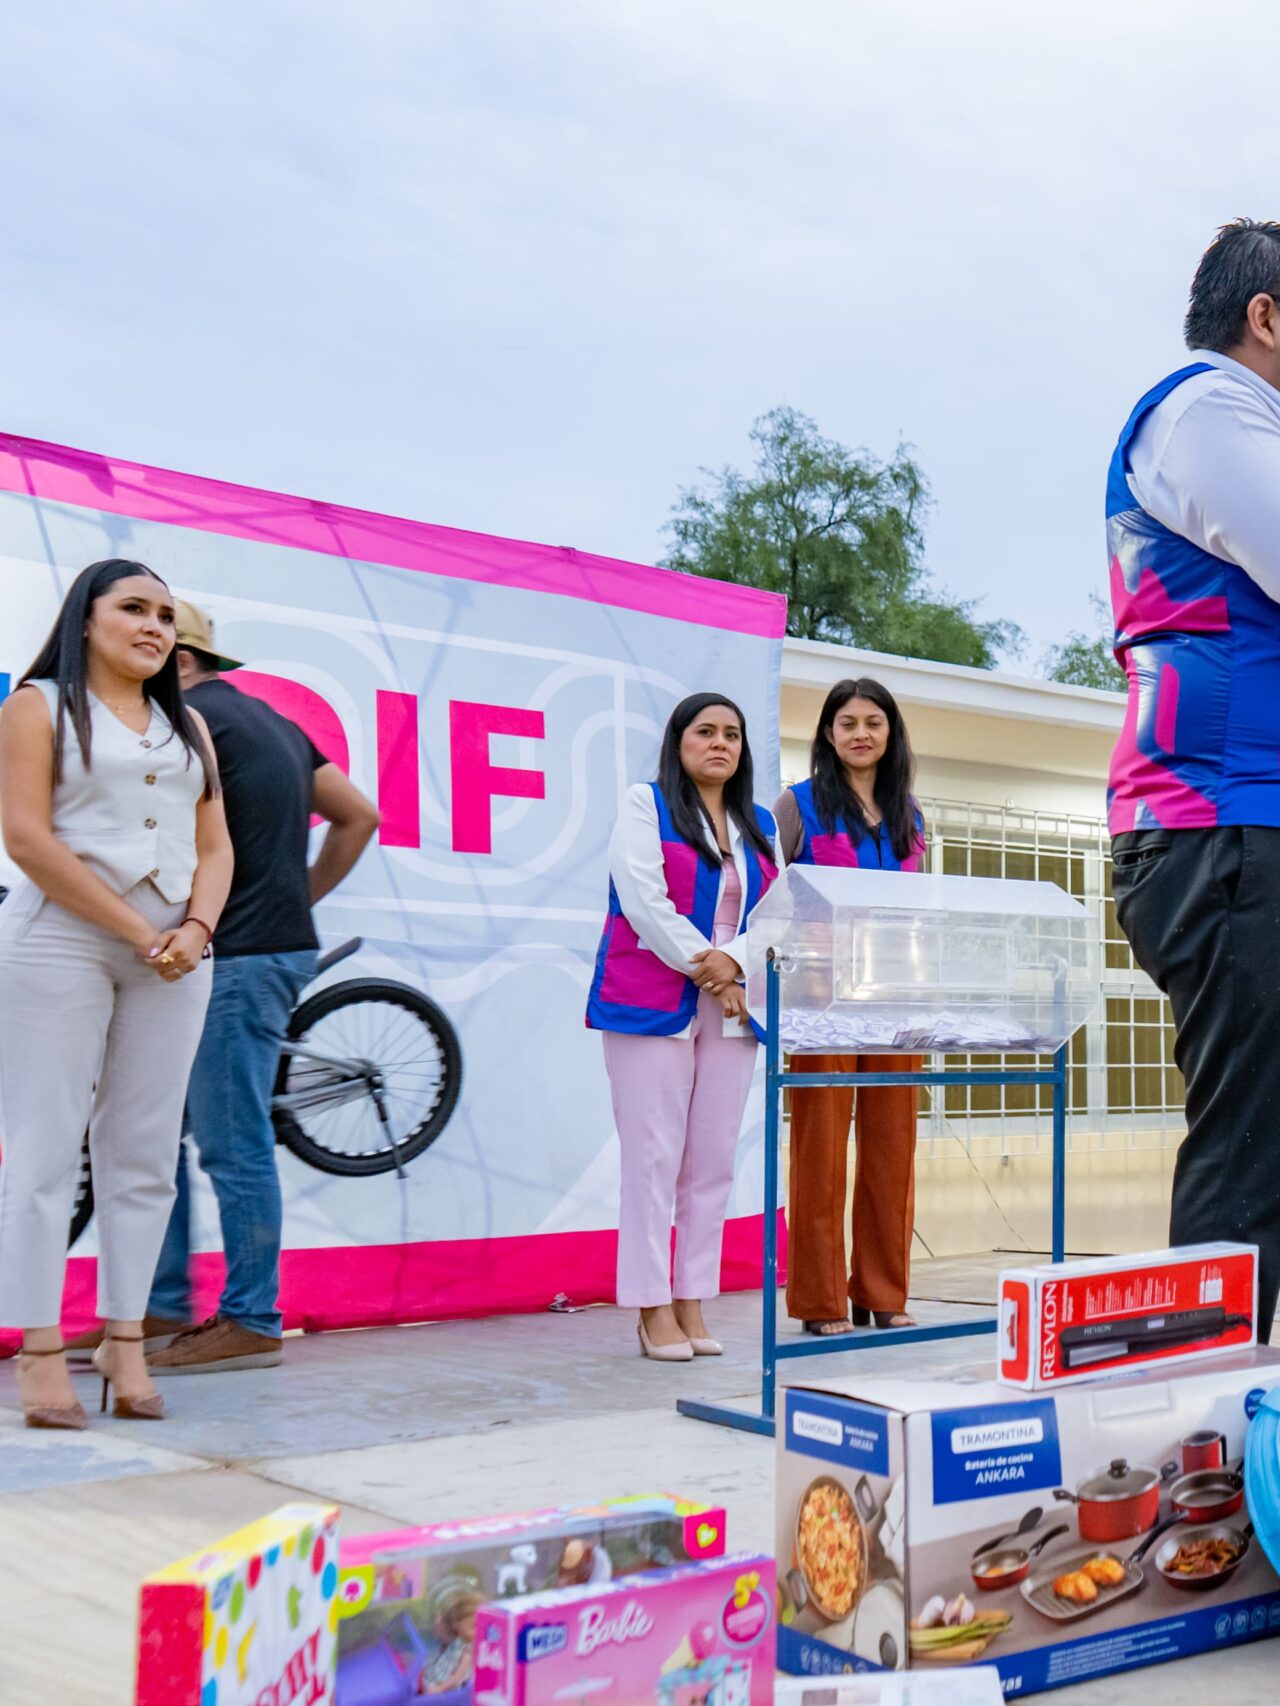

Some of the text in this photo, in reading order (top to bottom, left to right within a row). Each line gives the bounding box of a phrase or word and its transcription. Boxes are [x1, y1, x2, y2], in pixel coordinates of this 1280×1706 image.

[1042, 1282, 1058, 1379] REVLON
[960, 1426, 1036, 1447] TRAMONTINA
[975, 1464, 1025, 1486] ANKARA
[576, 1600, 654, 1656] Barbie
